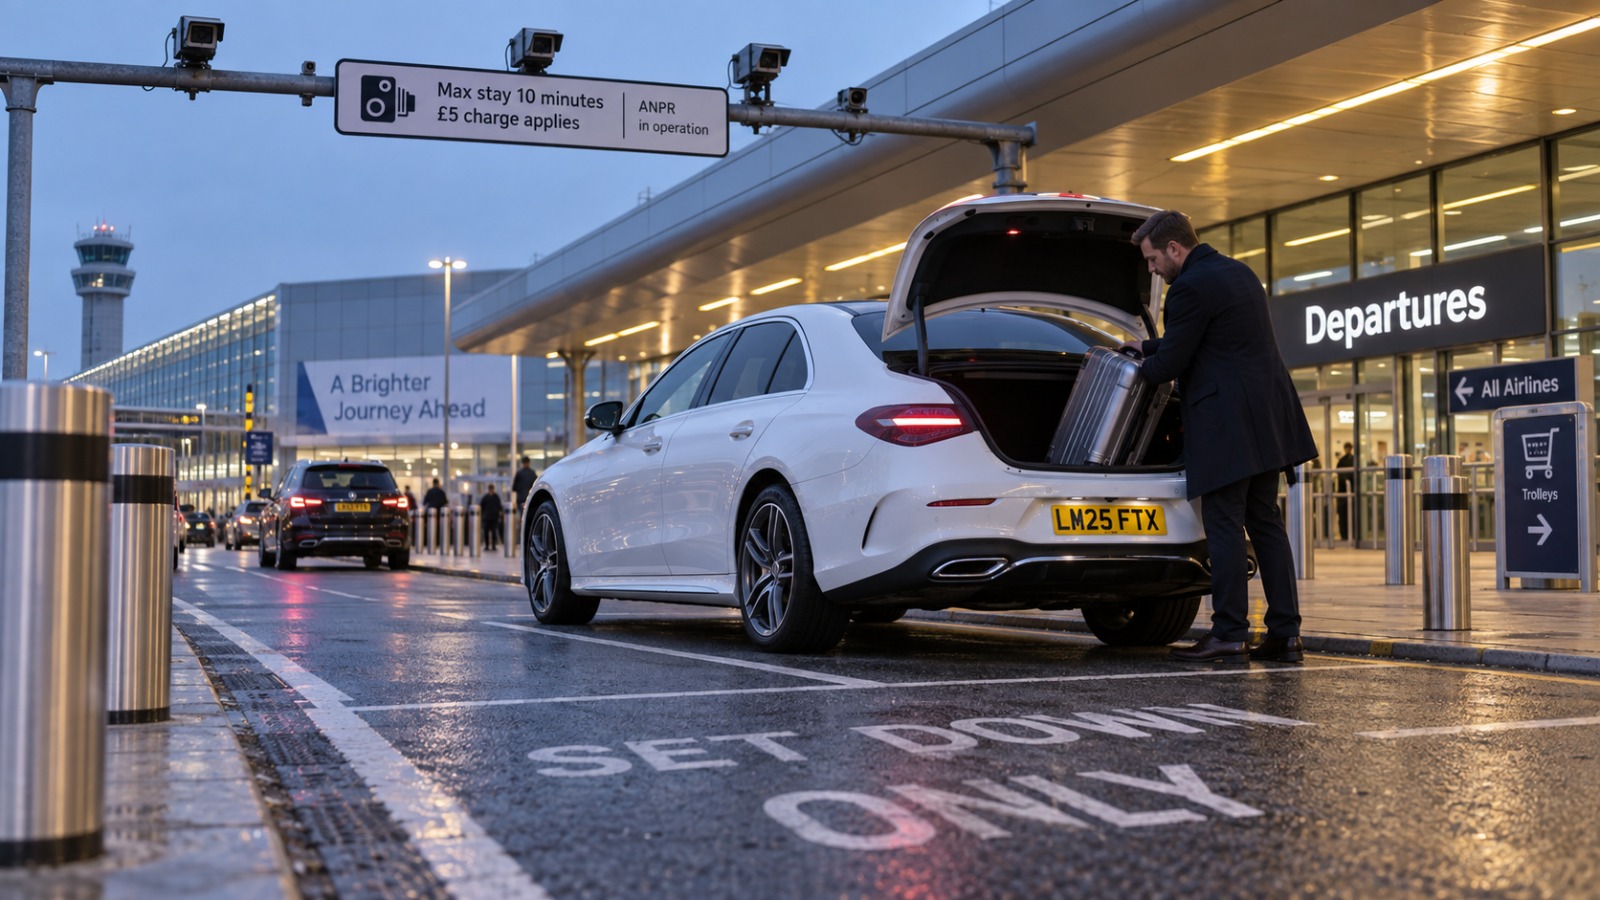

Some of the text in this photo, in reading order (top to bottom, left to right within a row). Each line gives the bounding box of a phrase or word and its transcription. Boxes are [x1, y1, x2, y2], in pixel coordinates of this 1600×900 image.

[437, 82, 604, 110] Max stay 10 minutes
[639, 100, 676, 115] ANPR
[437, 106, 580, 131] £5 charge applies
[639, 119, 709, 136] in operation
[1305, 285, 1487, 349] Departures
[330, 373, 431, 397] A Brighter
[1481, 376, 1559, 398] All Airlines
[334, 398, 486, 424] Journey Ahead
[1522, 488, 1558, 503] Trolleys
[1055, 508, 1159, 531] LM25 FTX
[528, 703, 1316, 777] SET DOWN
[762, 764, 1264, 851] ONLY
